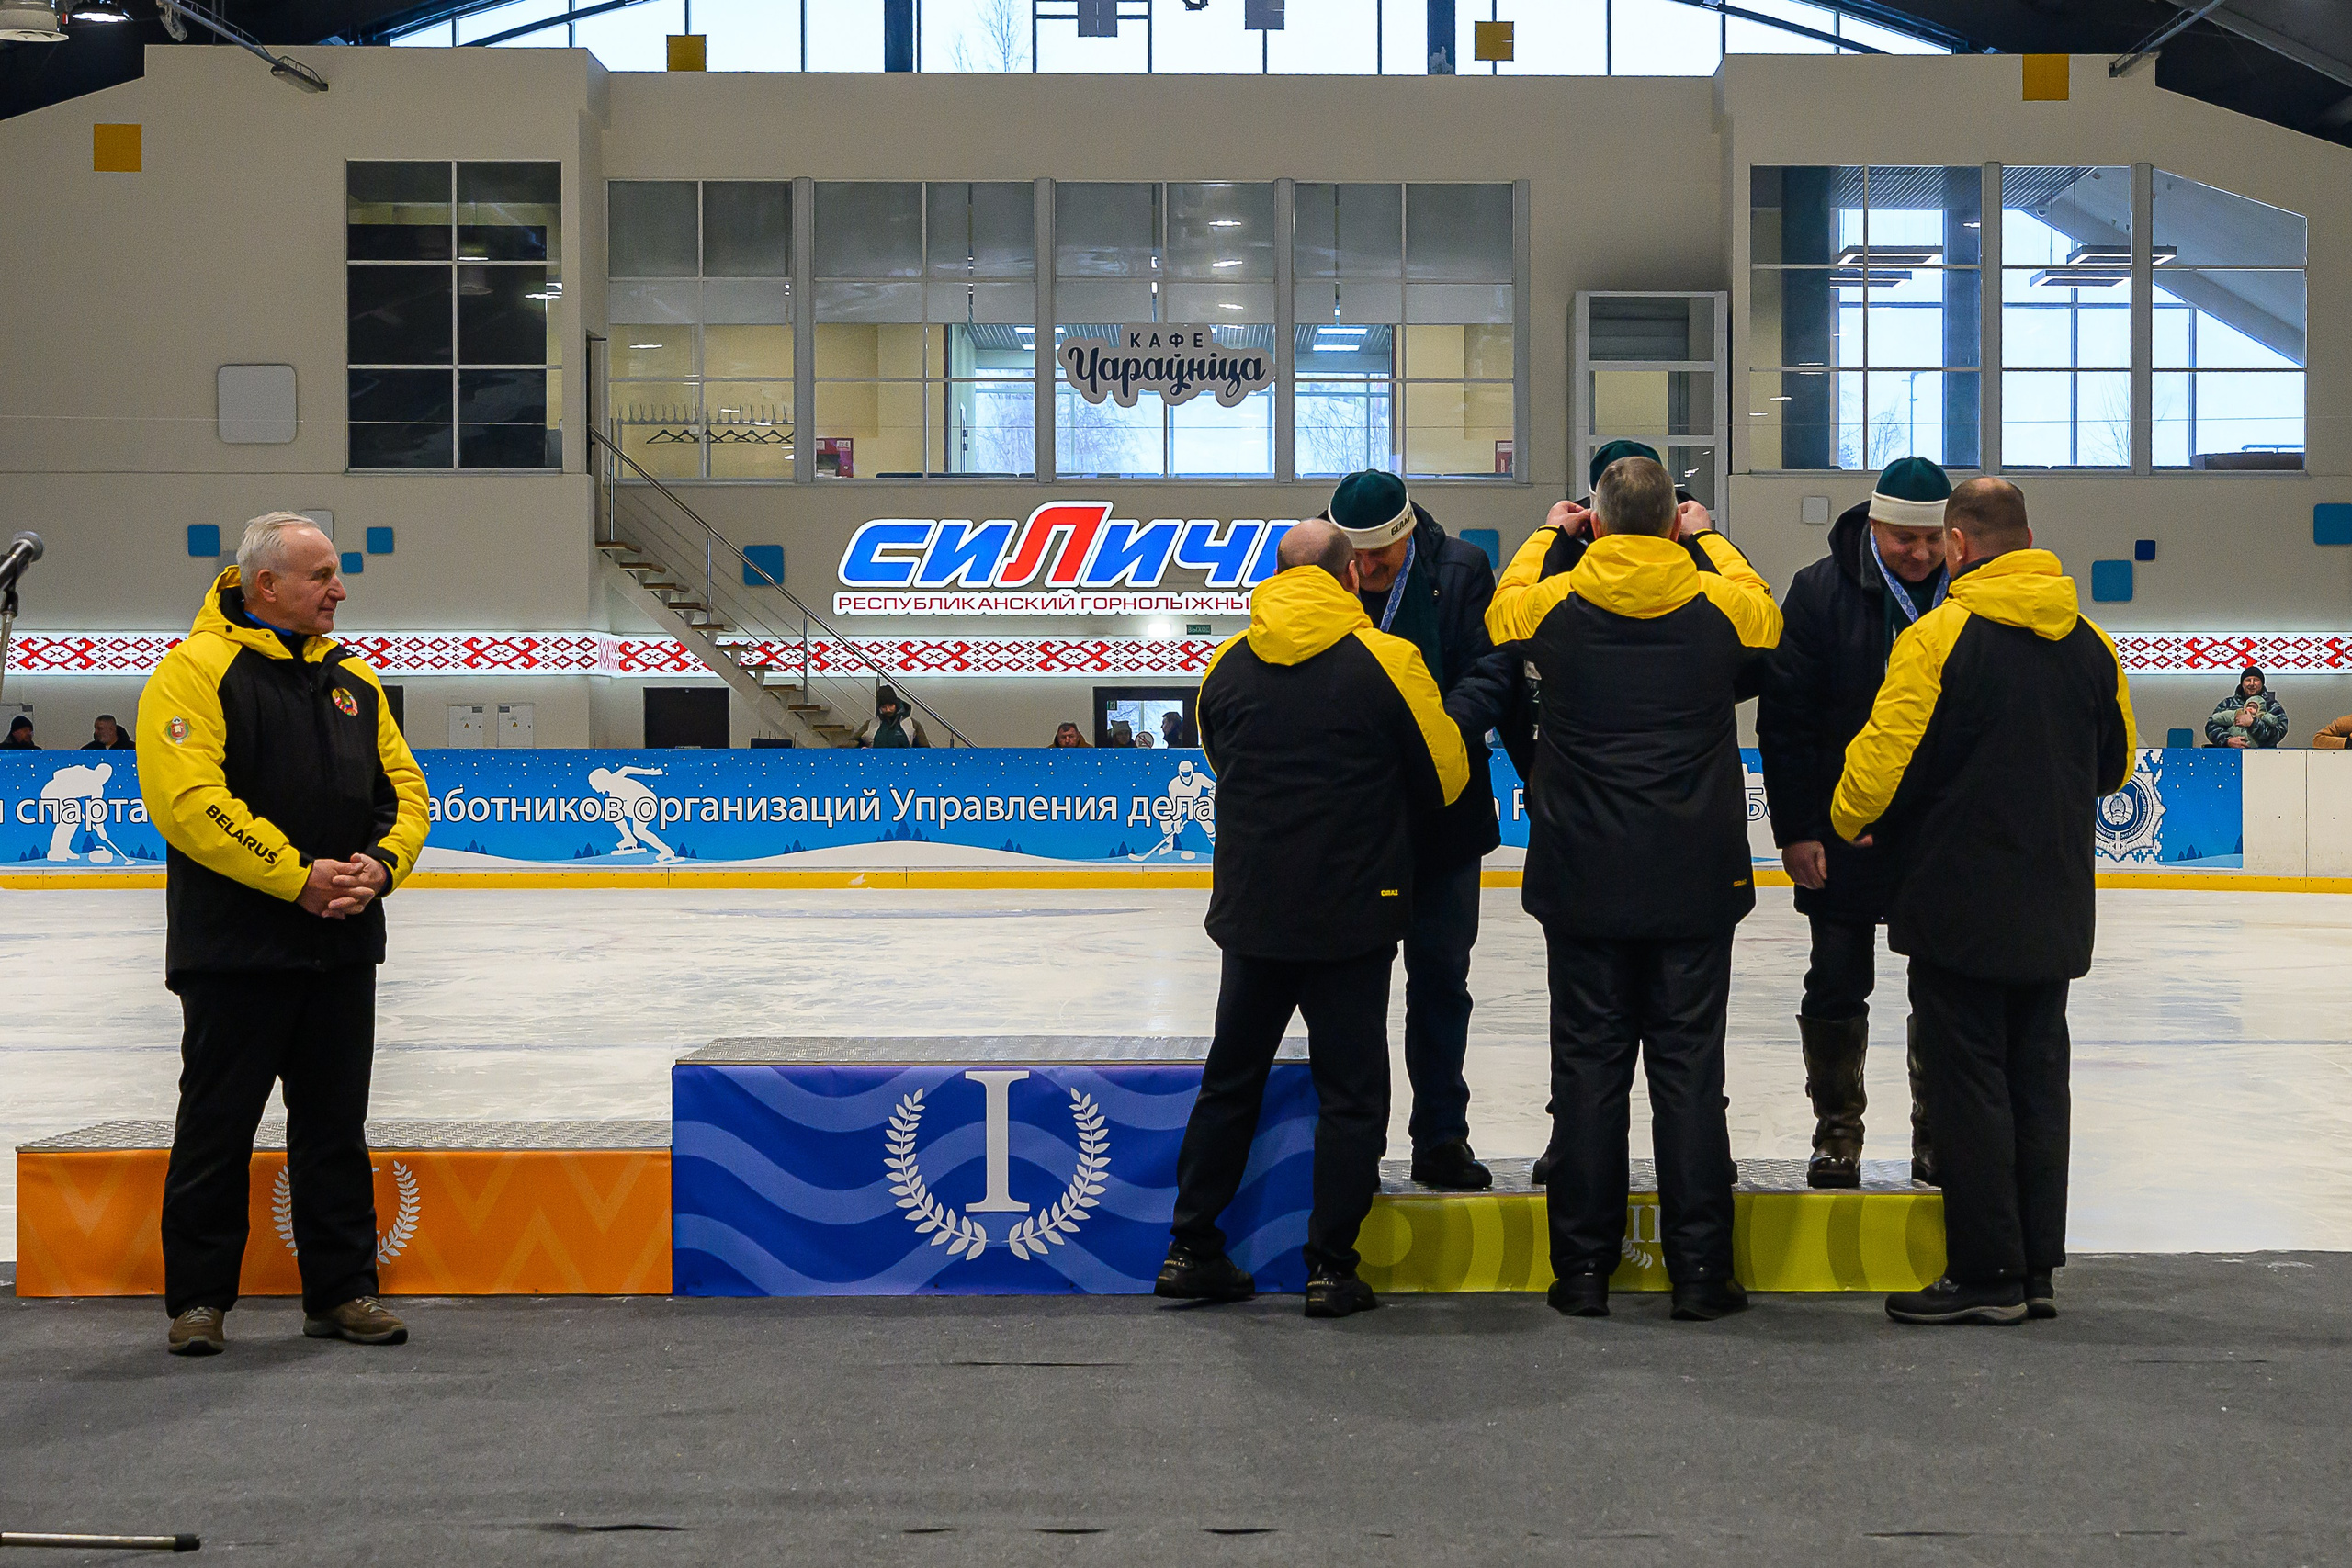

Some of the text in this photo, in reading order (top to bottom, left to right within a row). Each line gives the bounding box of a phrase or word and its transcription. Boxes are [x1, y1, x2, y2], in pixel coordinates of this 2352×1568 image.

[1129, 332, 1204, 348] КАФЕ
[1067, 346, 1267, 398] Чараўніца
[838, 593, 1250, 610] РЕСПУБЛИКАНСКИЙ ГОРНОЛЫЖНЫ
[16, 797, 149, 832] спарта
[429, 787, 625, 822] аботников
[634, 787, 881, 830] организаций
[889, 788, 1114, 830] Управления
[1127, 795, 1215, 827] дела
[205, 804, 278, 865] BELARUS
[1627, 1204, 1661, 1243] II
